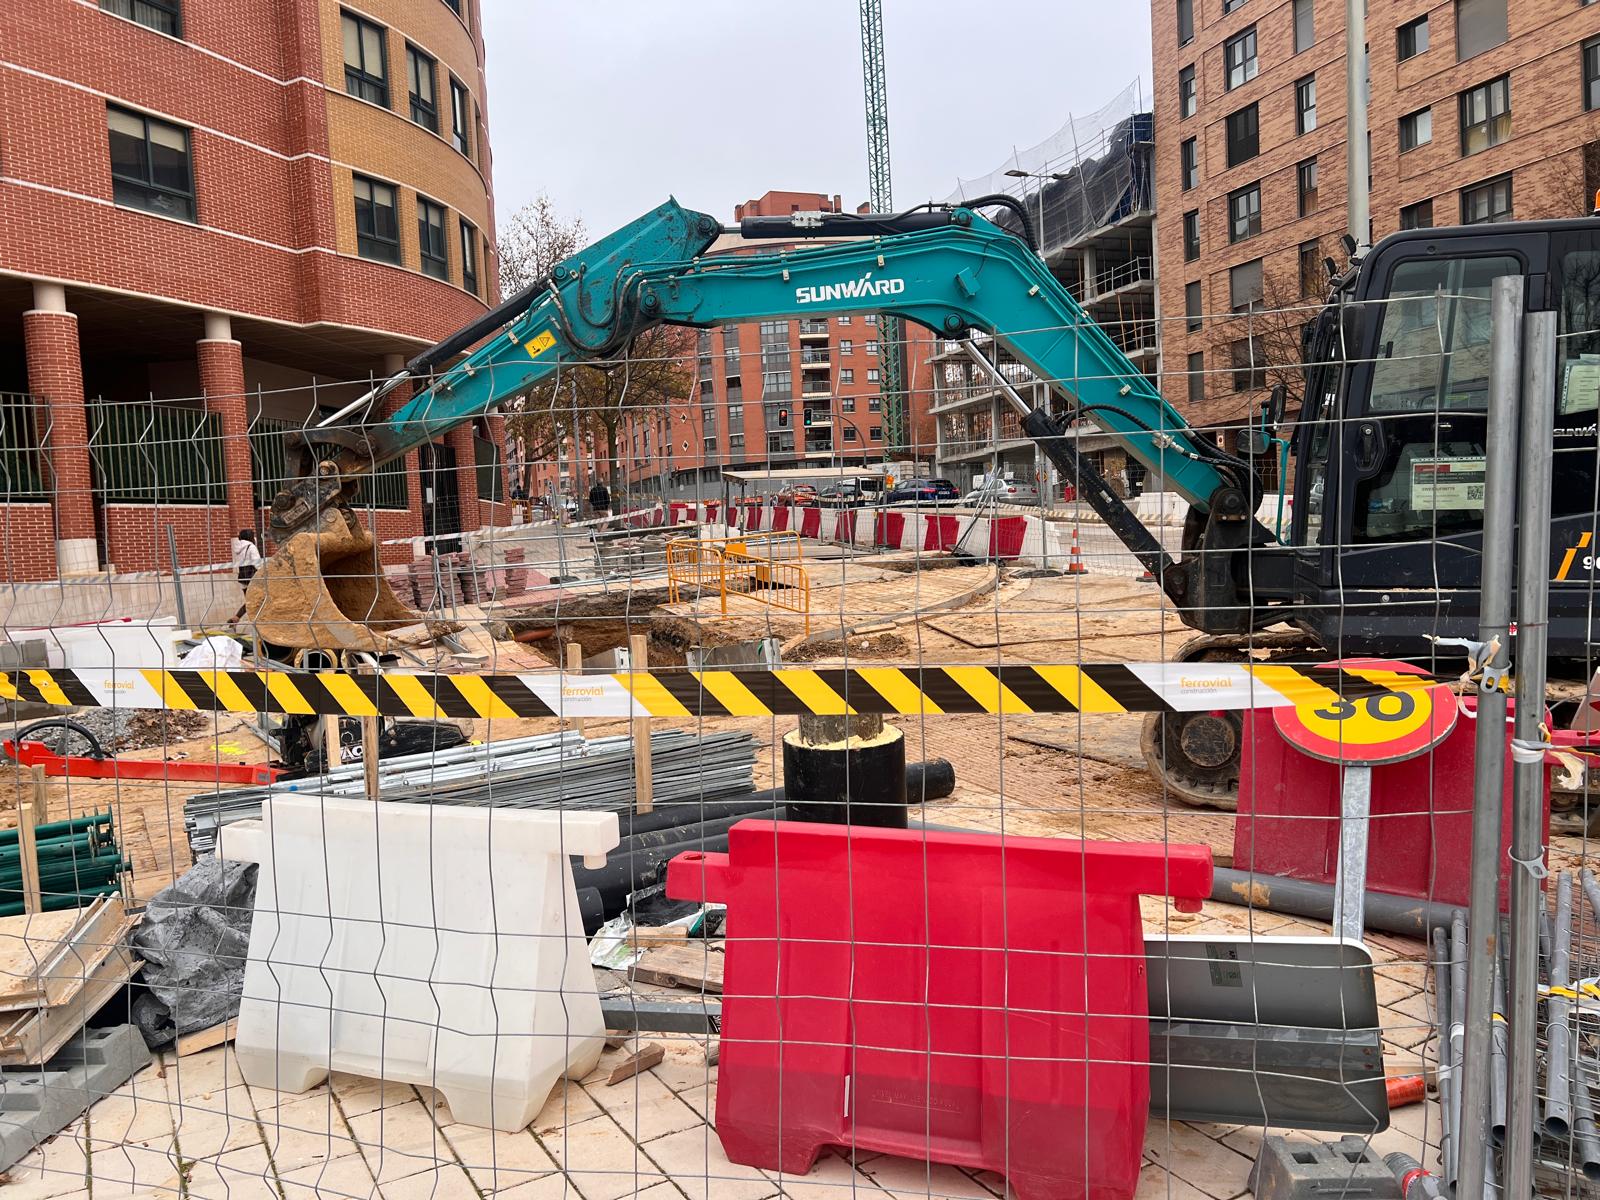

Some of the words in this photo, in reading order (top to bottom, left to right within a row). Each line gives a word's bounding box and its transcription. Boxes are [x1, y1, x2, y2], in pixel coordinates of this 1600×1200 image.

[796, 272, 905, 303] SUNWARD
[562, 686, 603, 695] ferrovial
[1180, 676, 1232, 688] ferrovial
[1314, 691, 1415, 721] 30
